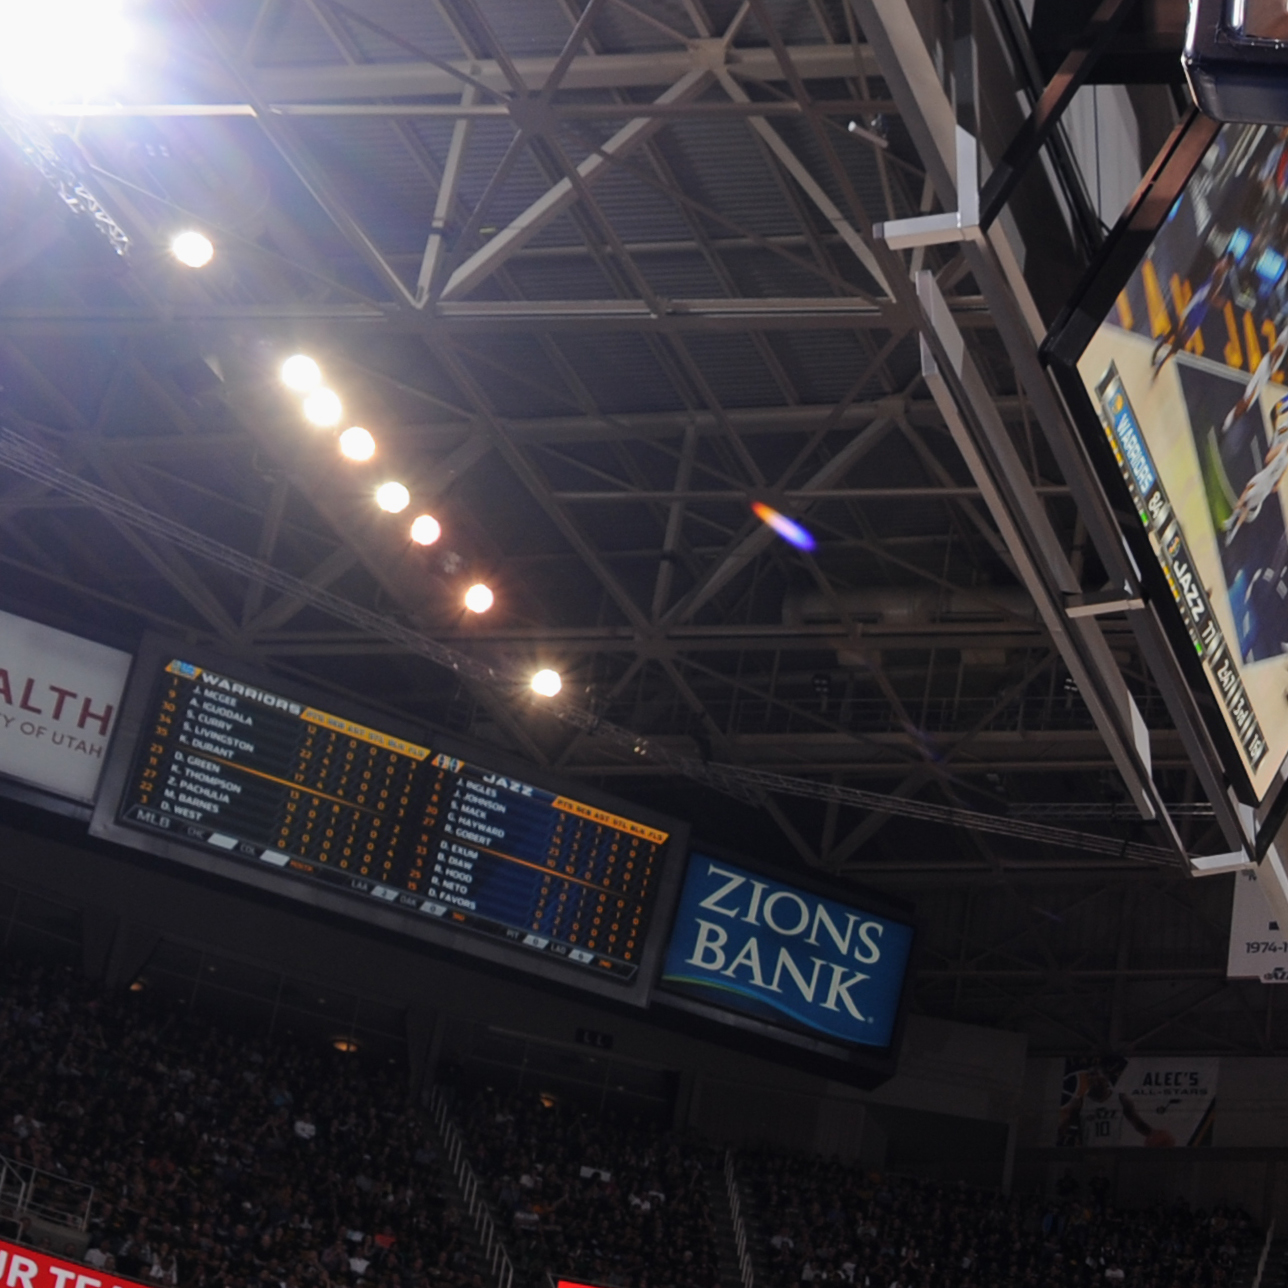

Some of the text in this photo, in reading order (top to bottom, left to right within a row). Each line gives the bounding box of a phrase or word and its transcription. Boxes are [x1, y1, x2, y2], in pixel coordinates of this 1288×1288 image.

[1115, 413, 1206, 623] WARRIORS JAZZ
[200, 672, 302, 716] WARRIORS
[203, 688, 238, 708] MCGEE
[198, 713, 233, 731] CURRY
[202, 700, 254, 726] IGUODALA
[20, 721, 103, 759] OF UTAH
[191, 737, 235, 760] DURANT
[194, 724, 254, 752] LIVINGSTON
[186, 754, 221, 773] GREEN
[179, 779, 230, 803] PACHULIA
[184, 767, 242, 794] THOMPSON
[466, 781, 497, 798] INGLES
[483, 772, 534, 797] JAZZ
[174, 804, 203, 821] WEST
[178, 792, 220, 813] BARNES
[461, 804, 487, 819] MACK
[463, 793, 506, 813] JOHNSON
[136, 808, 171, 829] MLB
[458, 815, 505, 838] HAYWARD
[455, 827, 491, 847] GOBERT
[451, 844, 479, 859] EXUM
[448, 855, 473, 871] DIAW
[445, 867, 473, 883] HOOD
[442, 879, 468, 895] NETO
[439, 890, 476, 911] FAVORS
[698, 863, 884, 965] ZIONS
[685, 918, 871, 1022] BANK
[1142, 1071, 1199, 1087] ALEC'S
[1131, 1088, 1208, 1096] ALL-STARS
